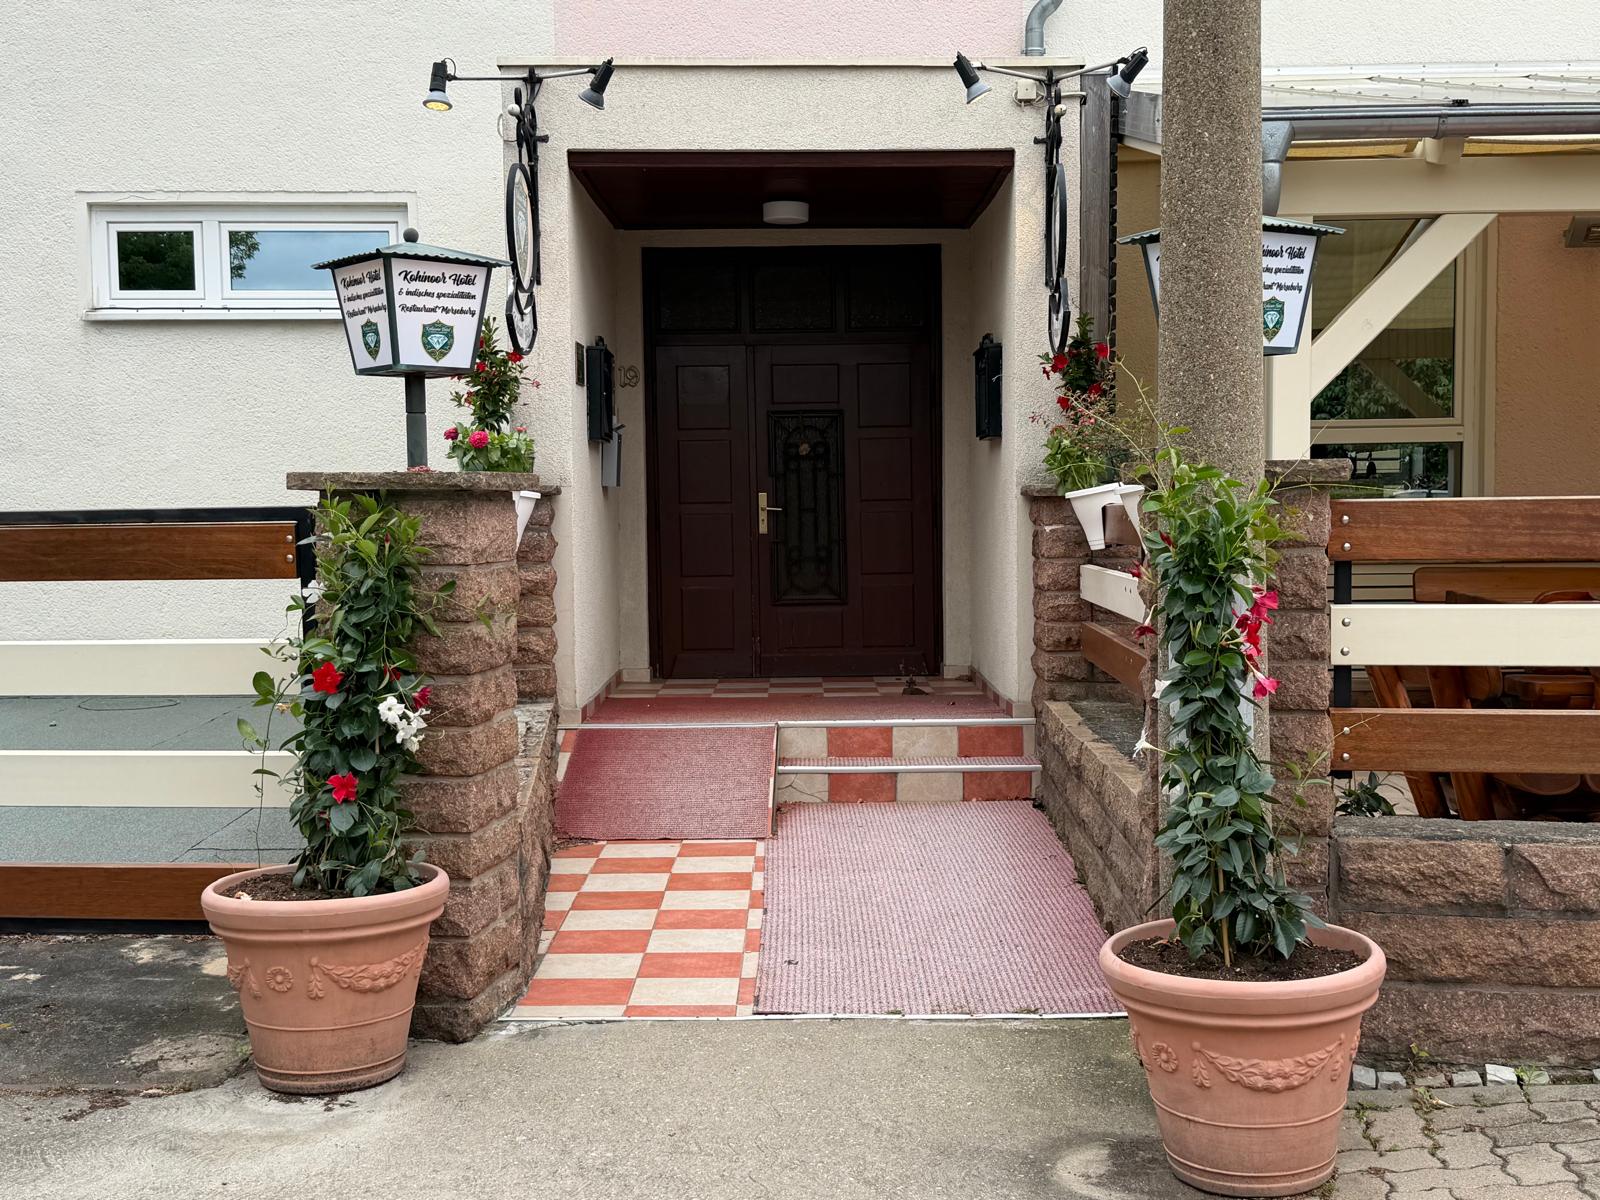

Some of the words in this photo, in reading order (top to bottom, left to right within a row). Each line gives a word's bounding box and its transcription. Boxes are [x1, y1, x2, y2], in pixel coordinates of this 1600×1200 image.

[1262, 244, 1284, 258] hinoor
[1284, 245, 1307, 260] Hotel
[365, 268, 381, 284] Hotel
[398, 270, 447, 284] Kohinoor
[448, 273, 477, 287] Hotel
[398, 288, 404, 296] &
[405, 288, 435, 298] indisches
[1274, 281, 1303, 294] Merseburg
[398, 304, 438, 313] Restaurant
[438, 305, 477, 318] Merseburg
[618, 365, 641, 388] 19
